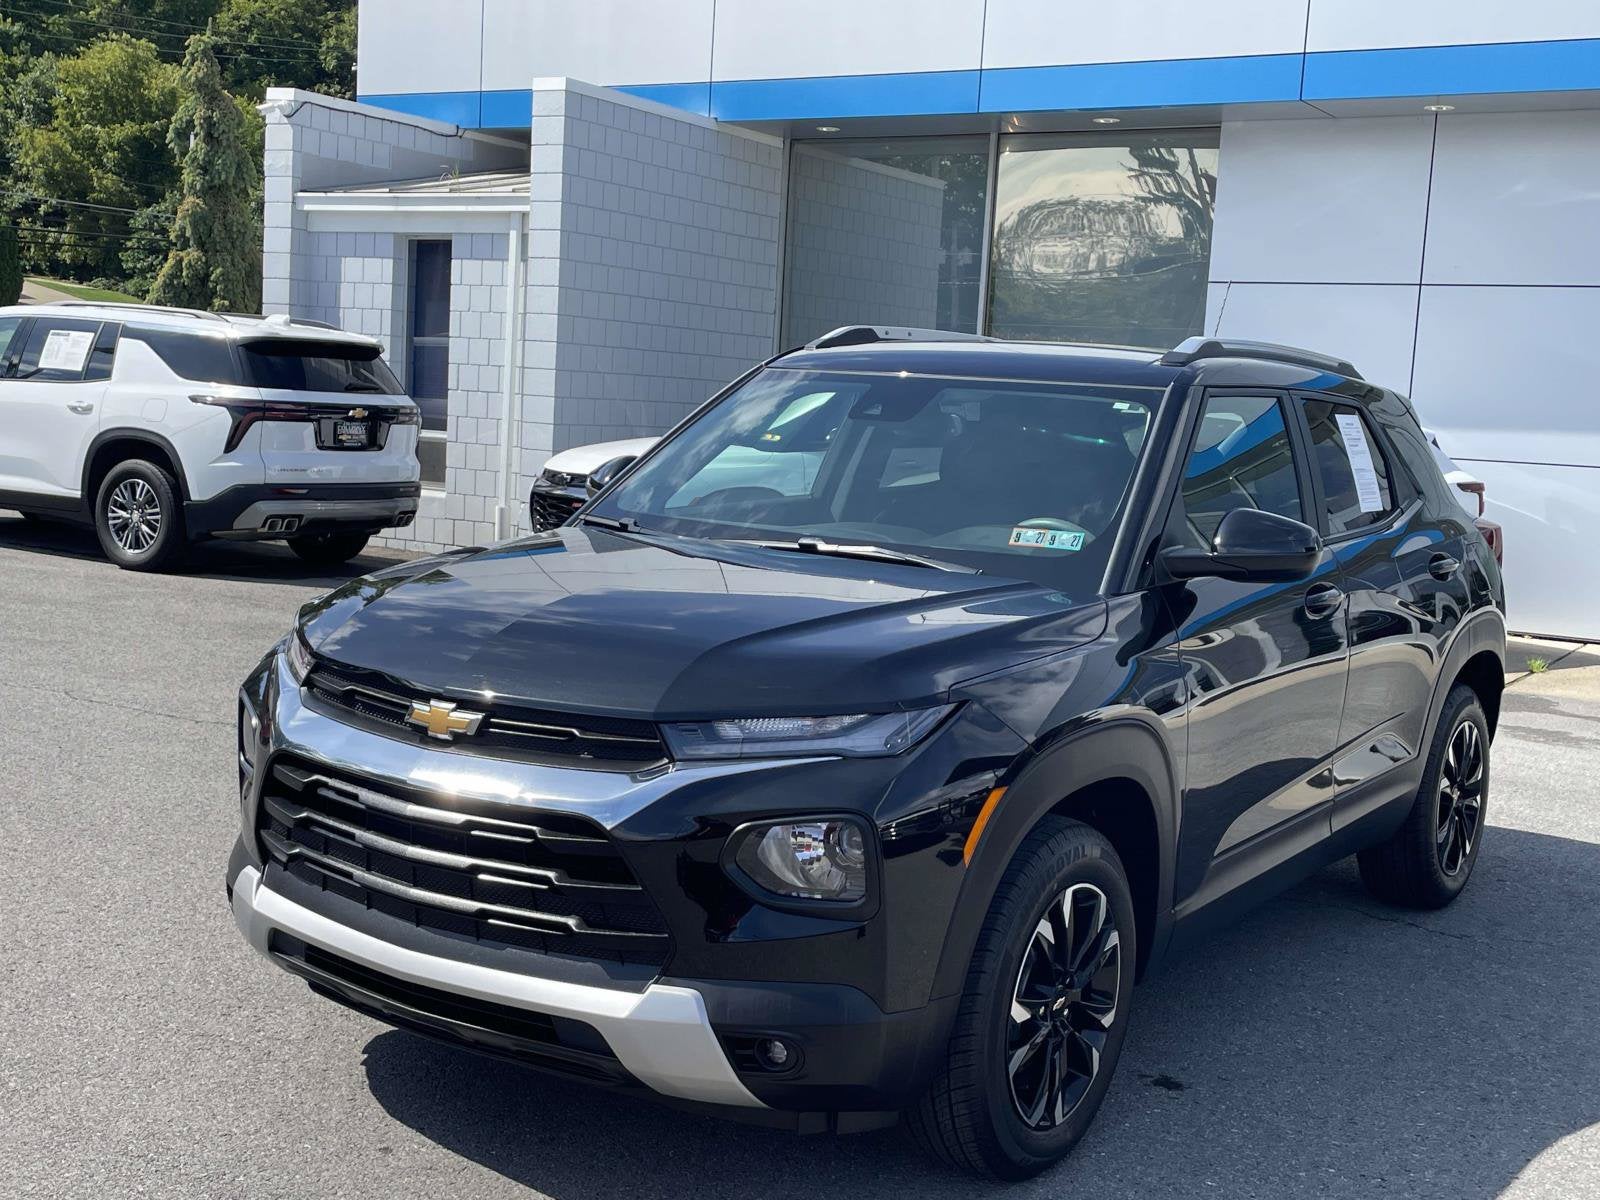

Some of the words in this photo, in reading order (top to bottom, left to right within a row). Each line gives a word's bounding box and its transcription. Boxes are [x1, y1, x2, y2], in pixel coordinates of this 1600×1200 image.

[1014, 532, 1022, 543] 9
[1035, 532, 1046, 545] 27
[1049, 534, 1057, 546] 9
[1070, 535, 1082, 548] 27
